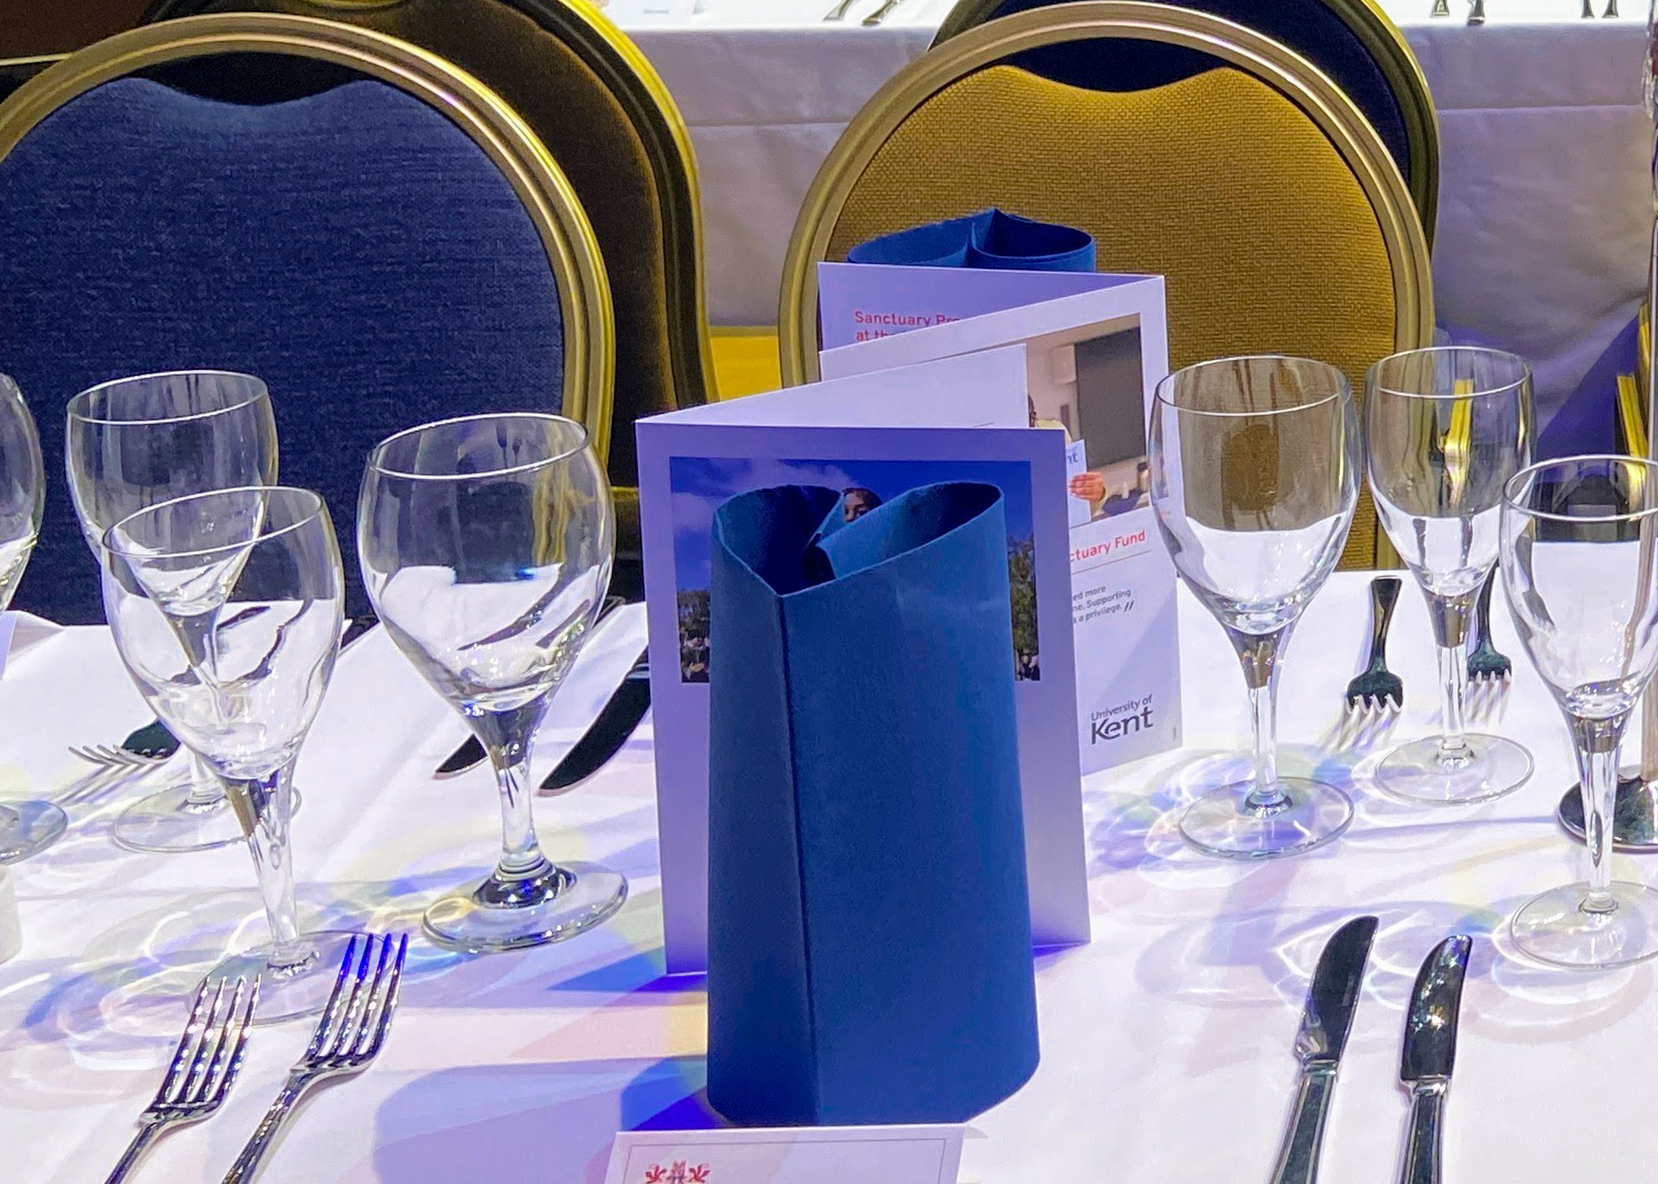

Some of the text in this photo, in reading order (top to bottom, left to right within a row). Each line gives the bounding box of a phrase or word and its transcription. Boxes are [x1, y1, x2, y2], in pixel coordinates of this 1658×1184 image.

[854, 311, 931, 327] Sanctuary
[856, 330, 869, 341] at
[1070, 529, 1145, 562] ctuary Fund
[1073, 586, 1107, 601] ed more
[1087, 589, 1131, 609] Supporting
[1091, 693, 1153, 721] University of
[1091, 706, 1153, 745] Kent
